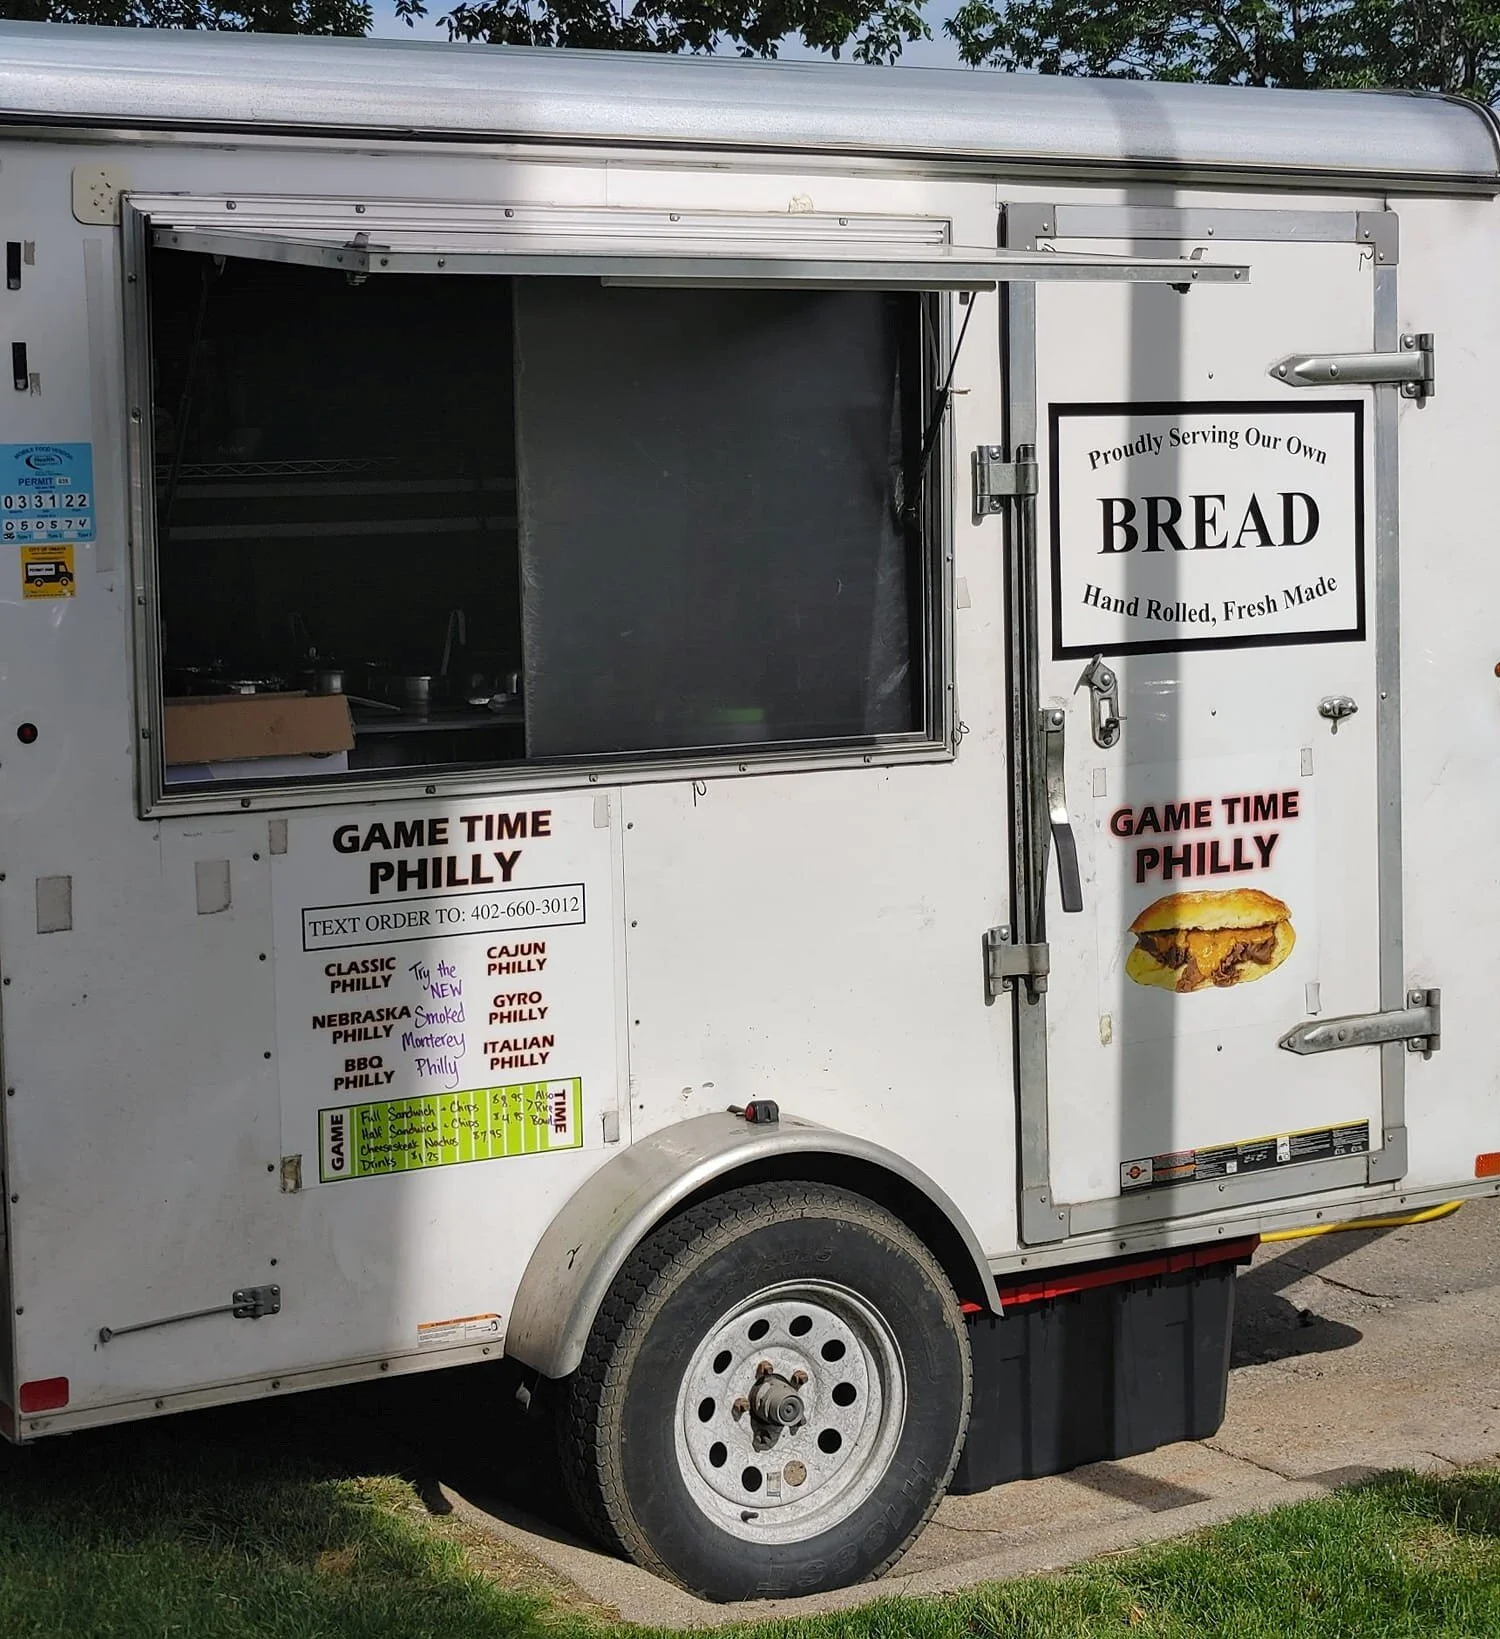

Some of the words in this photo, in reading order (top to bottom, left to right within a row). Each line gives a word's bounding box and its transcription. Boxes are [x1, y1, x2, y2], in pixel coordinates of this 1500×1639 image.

[1088, 432, 1163, 470] Proudly
[1169, 425, 1239, 449] Serving
[1245, 426, 1281, 450] Our
[1287, 435, 1327, 464] Own
[18, 477, 53, 486] PERMIT
[1096, 491, 1320, 555] BREAD
[1081, 583, 1139, 618] Hand
[1145, 598, 1216, 626] Rolled,
[1224, 594, 1278, 622] Fresh
[1283, 576, 1338, 609] Made
[1110, 800, 1212, 837] GAME
[1221, 791, 1299, 825] TIME
[333, 817, 449, 854] GAME
[460, 810, 552, 843] TIME
[1136, 834, 1279, 883] PHILLY
[370, 850, 523, 895] PHILLY
[309, 917, 361, 938] TEXT
[365, 911, 431, 931] ORDER
[436, 907, 466, 925] TO:
[471, 896, 580, 921] 402-660-3012
[486, 942, 546, 960] CAJUN
[324, 957, 396, 977] CLASSIC
[408, 960, 431, 990] Try
[437, 960, 457, 978] the
[487, 958, 547, 976] PHILLY
[330, 974, 392, 994] PHILLY
[430, 979, 463, 999] NEW
[493, 991, 543, 1008] GYRO
[312, 1005, 411, 1030] NEBRASKA
[414, 1002, 465, 1029] Smoked
[488, 1007, 549, 1025] PHILLY
[332, 1024, 394, 1044] PHILLY
[402, 1031, 466, 1059] Monterey
[483, 1034, 555, 1055] ITALIAN
[344, 1055, 383, 1073] BBQ
[490, 1052, 550, 1071] PHILLY
[334, 1070, 395, 1091] PHILLY
[415, 1056, 460, 1090] Philly
[535, 1090, 554, 1100] Also
[361, 1109, 381, 1125] Full
[388, 1104, 435, 1121] Sandwich
[450, 1101, 479, 1116] Chips
[535, 1101, 553, 1113] Rice
[554, 1089, 567, 1134] TIME
[361, 1127, 383, 1141] Half
[389, 1122, 438, 1138] Sandwich
[451, 1116, 480, 1131] Chips
[331, 1114, 344, 1171] GAME
[425, 1136, 459, 1149] Nachos
[362, 1155, 397, 1171] Drinks
